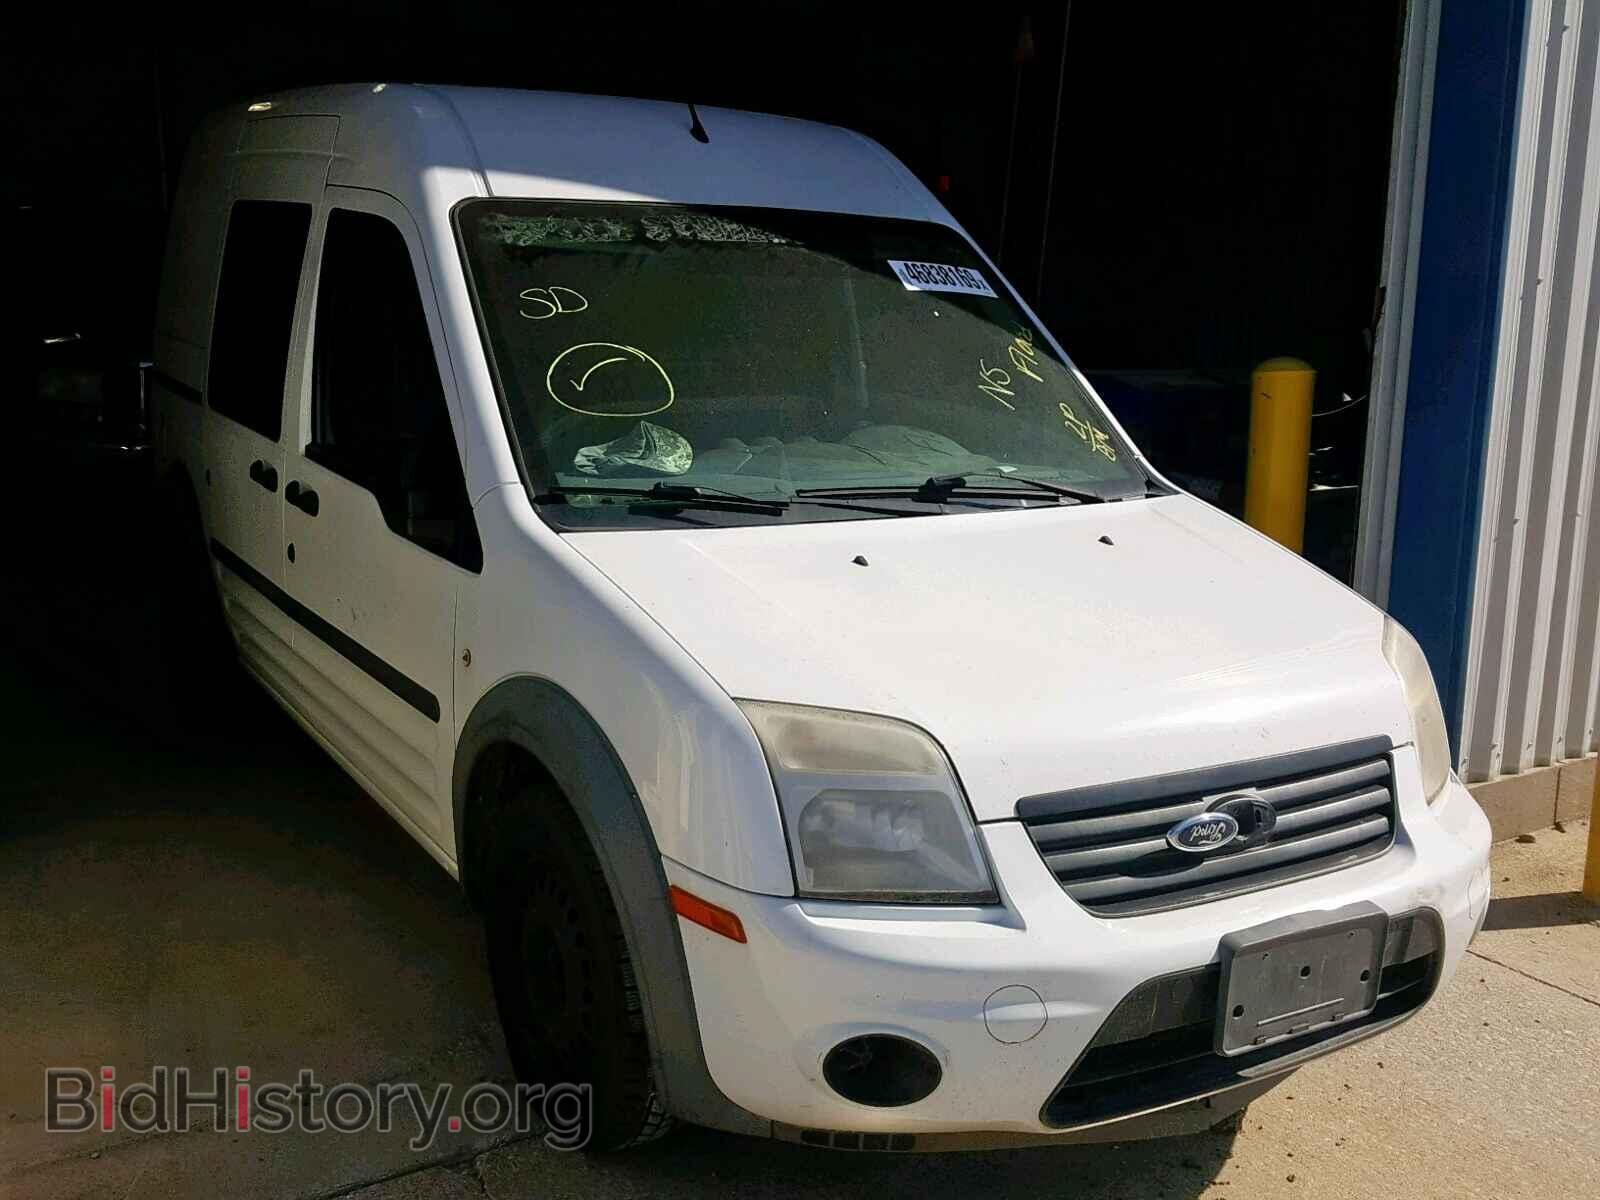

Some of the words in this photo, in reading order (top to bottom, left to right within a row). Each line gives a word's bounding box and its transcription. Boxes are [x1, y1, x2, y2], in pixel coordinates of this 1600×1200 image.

[903, 263, 981, 289] 46838169
[519, 286, 588, 319] SD
[1188, 821, 1226, 846] Ford
